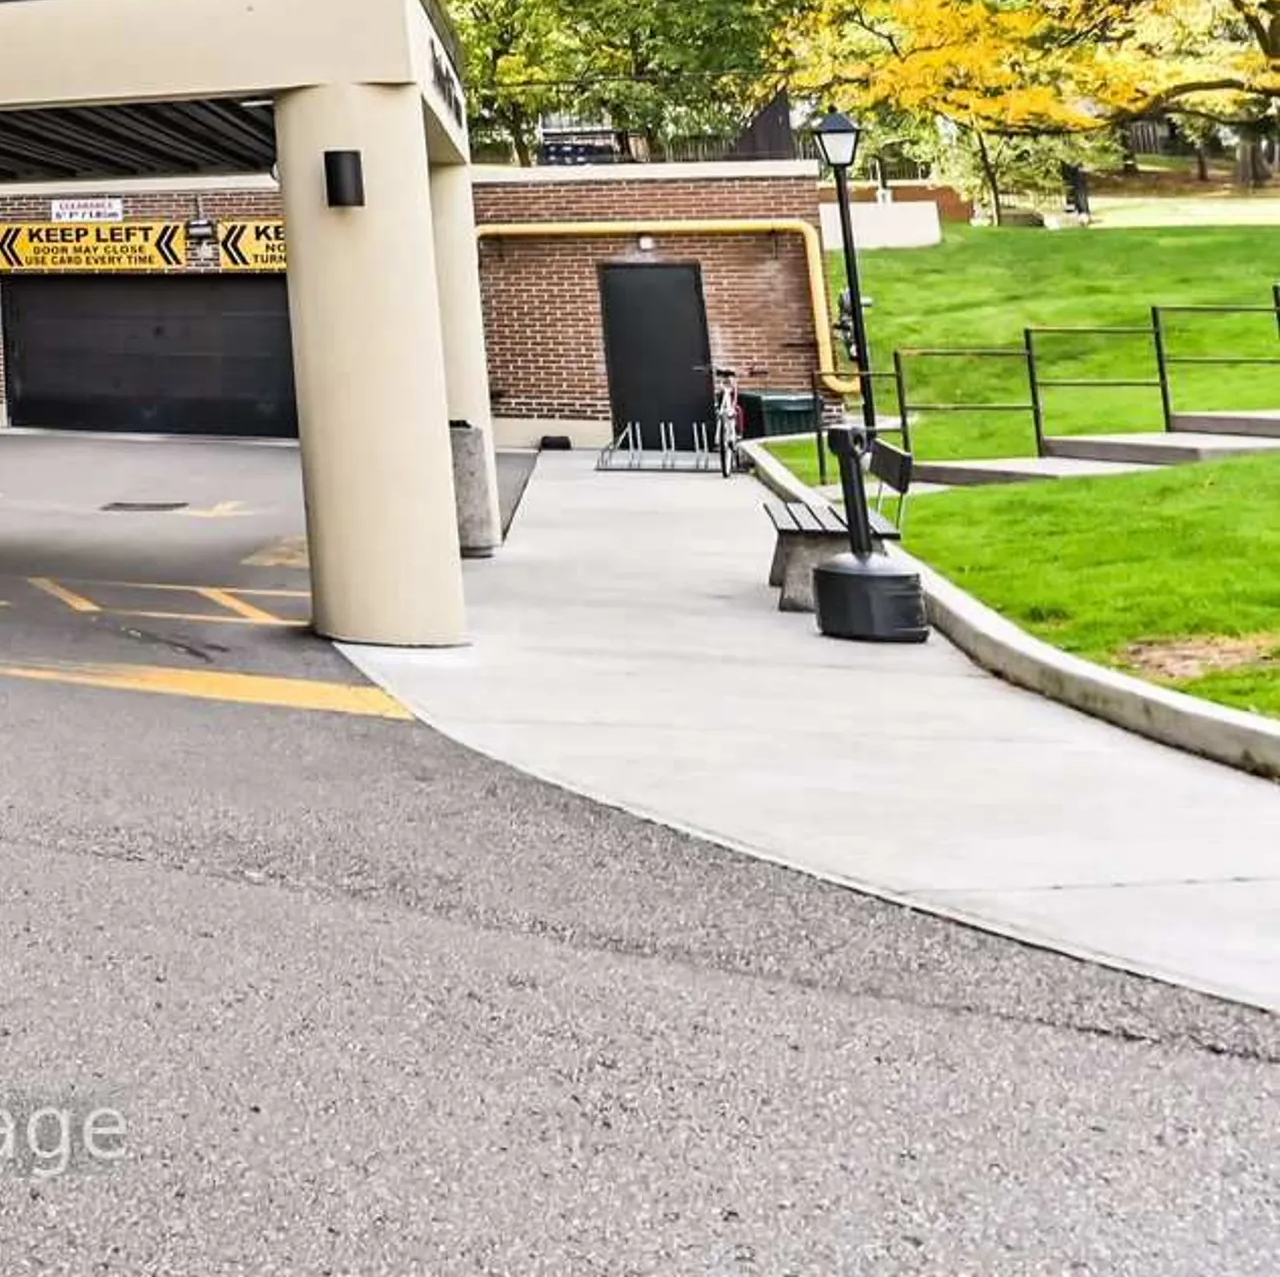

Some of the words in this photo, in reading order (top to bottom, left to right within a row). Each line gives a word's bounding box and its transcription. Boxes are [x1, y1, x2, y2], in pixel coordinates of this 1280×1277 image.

[27, 227, 88, 243] KEEP
[95, 227, 153, 243] LEFT
[254, 225, 286, 241] KE
[33, 246, 68, 255] DOOR
[73, 246, 100, 255] MAY
[104, 246, 145, 254] CLOSE
[25, 256, 48, 265] USE
[51, 256, 83, 265] CARD
[85, 256, 125, 265] EVERY
[128, 256, 154, 265] TIME
